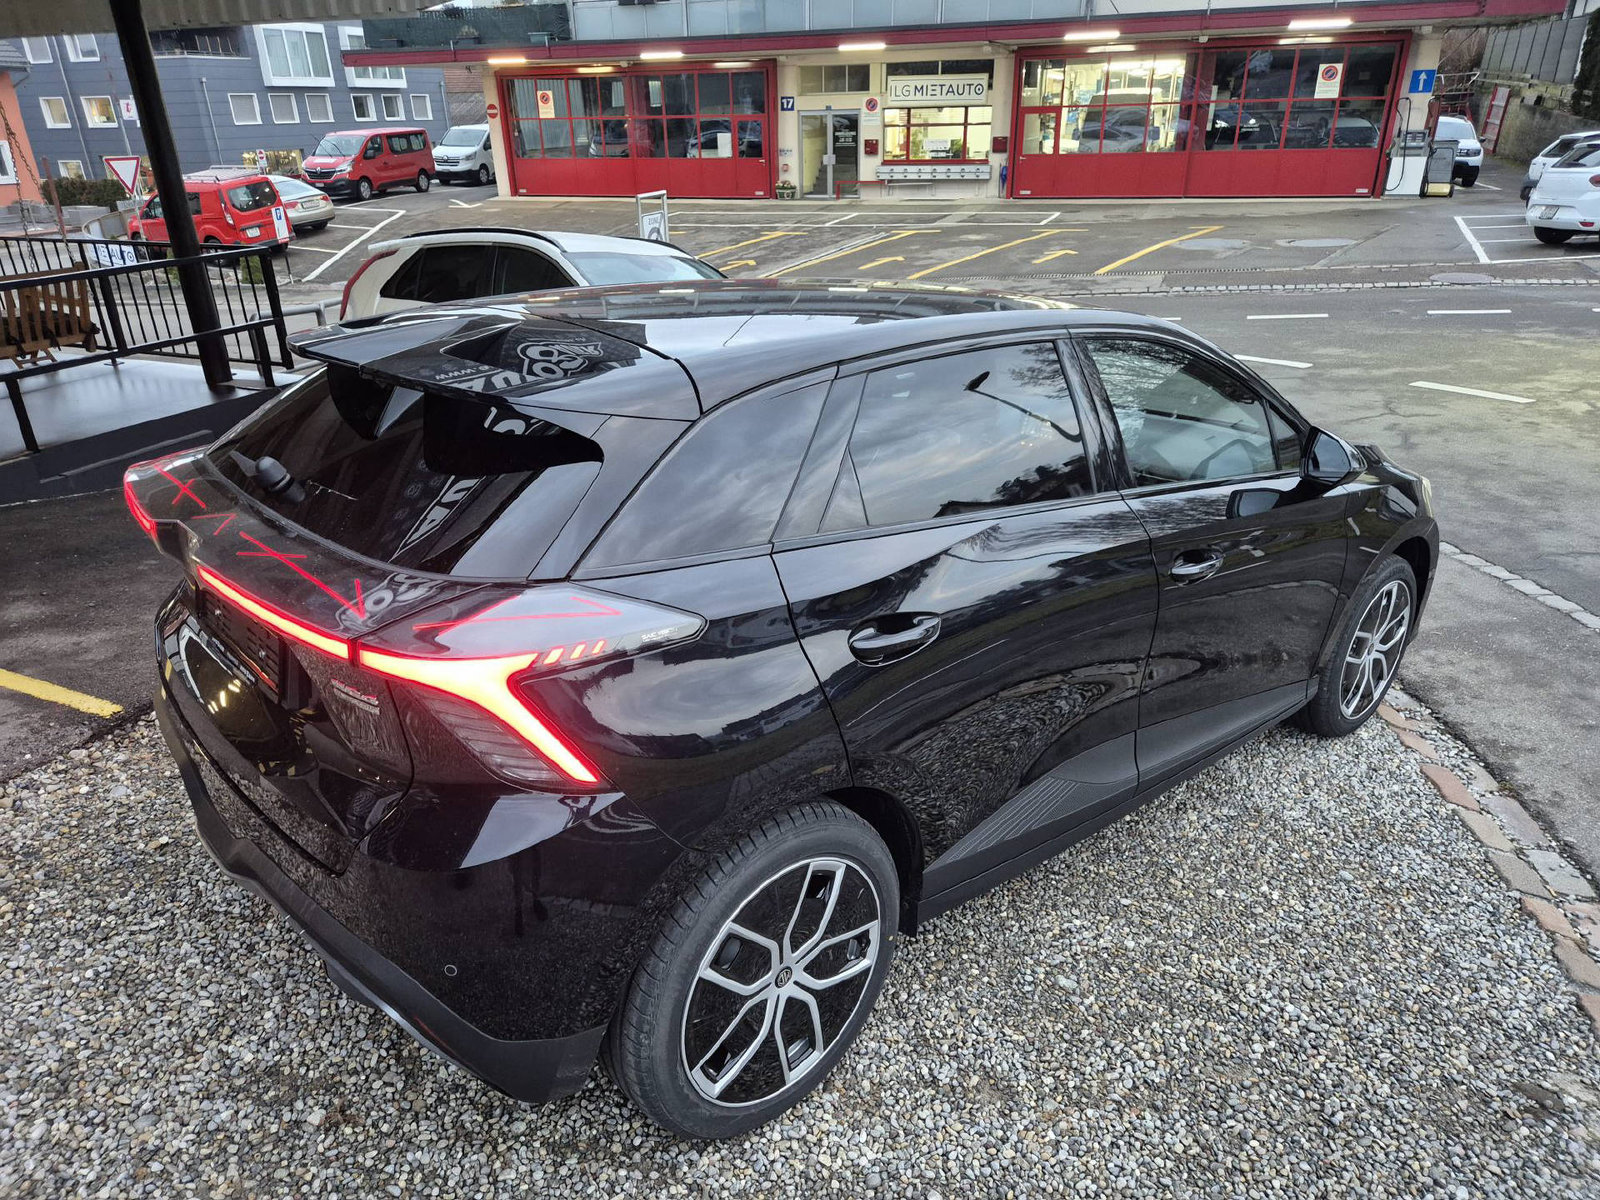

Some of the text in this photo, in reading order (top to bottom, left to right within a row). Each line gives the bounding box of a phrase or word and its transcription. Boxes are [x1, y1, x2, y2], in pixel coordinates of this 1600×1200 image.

[889, 83, 985, 97] ILG MIETAUTO
[782, 98, 794, 109] 17
